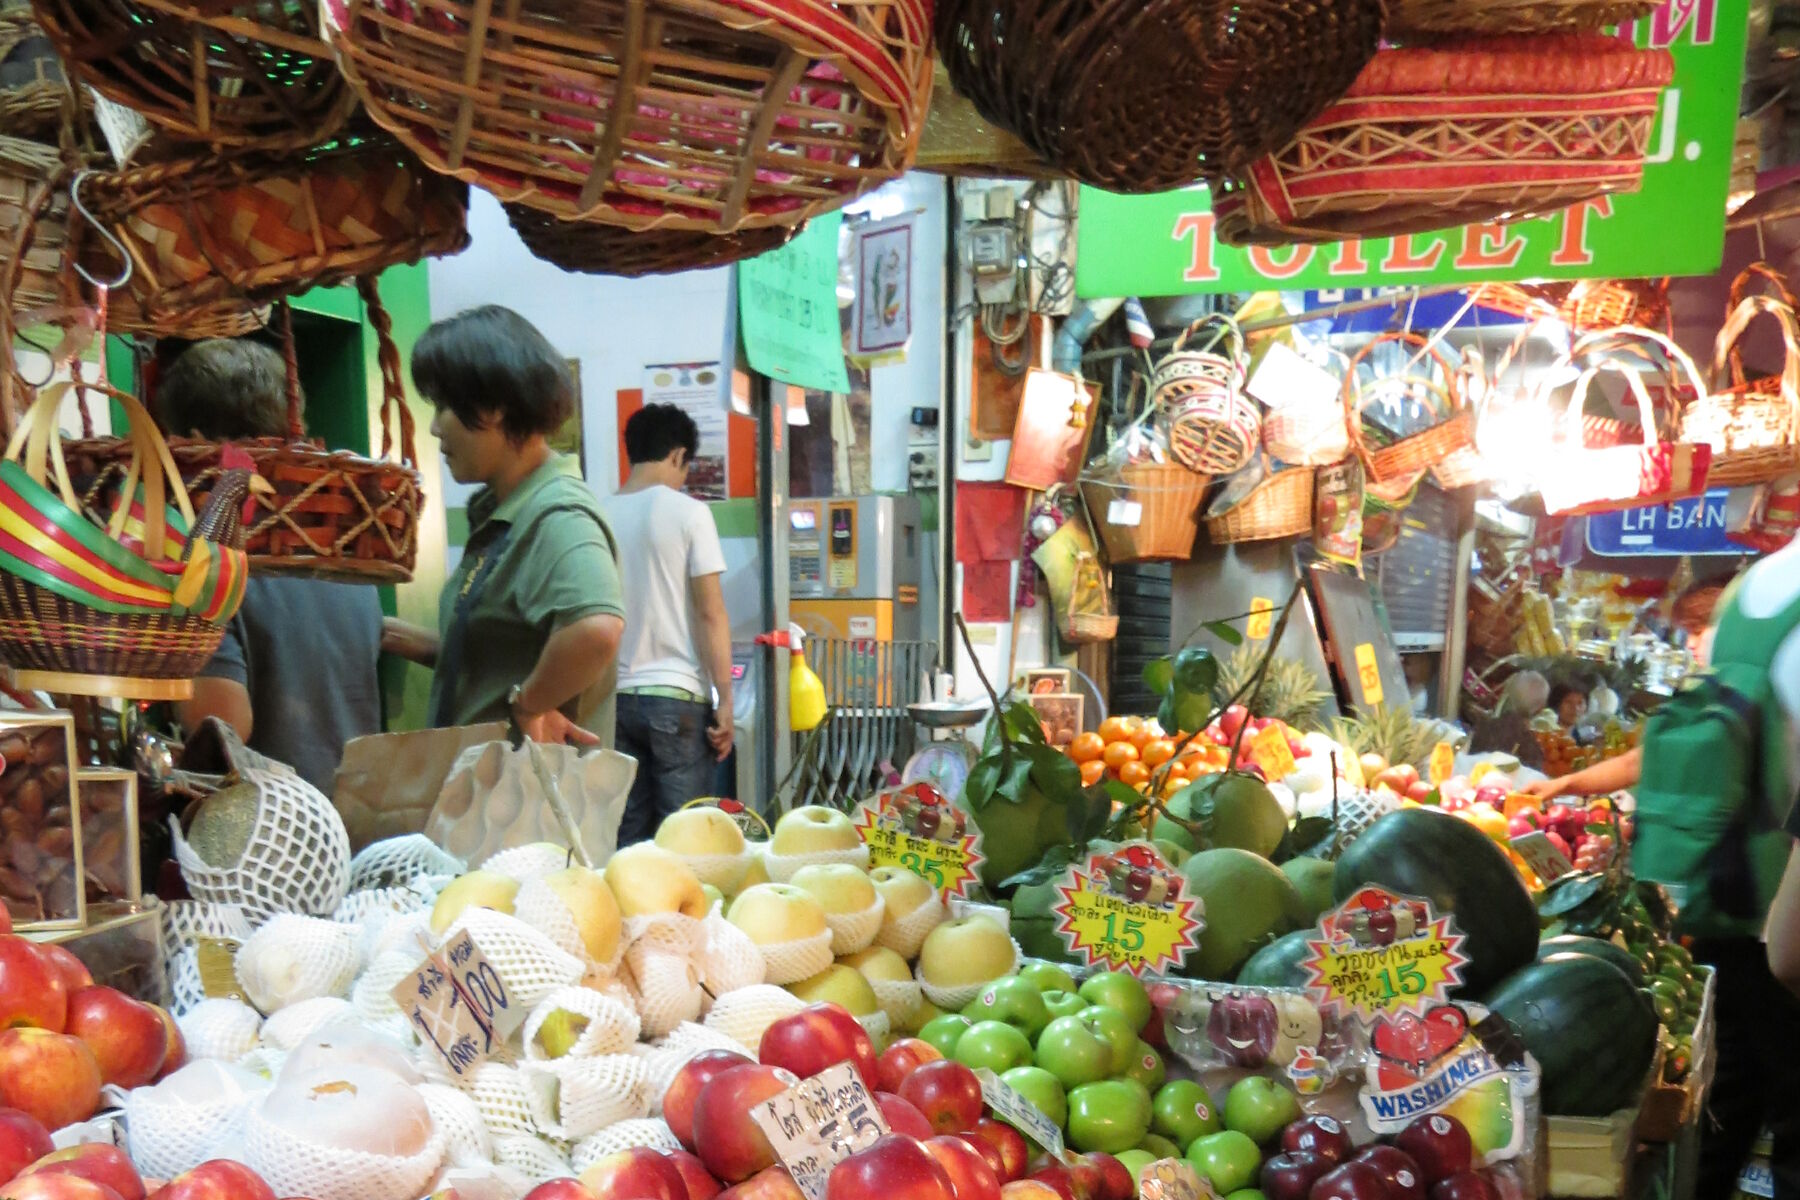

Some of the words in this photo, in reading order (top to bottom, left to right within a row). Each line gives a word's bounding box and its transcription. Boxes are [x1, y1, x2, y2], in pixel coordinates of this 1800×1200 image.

[1622, 508, 1656, 530] LH
[1666, 505, 1727, 529] BAN
[900, 852, 945, 889] 35
[1101, 912, 1147, 951] 15
[1375, 960, 1427, 1000] 15
[1370, 1048, 1494, 1119] WASHINGT
